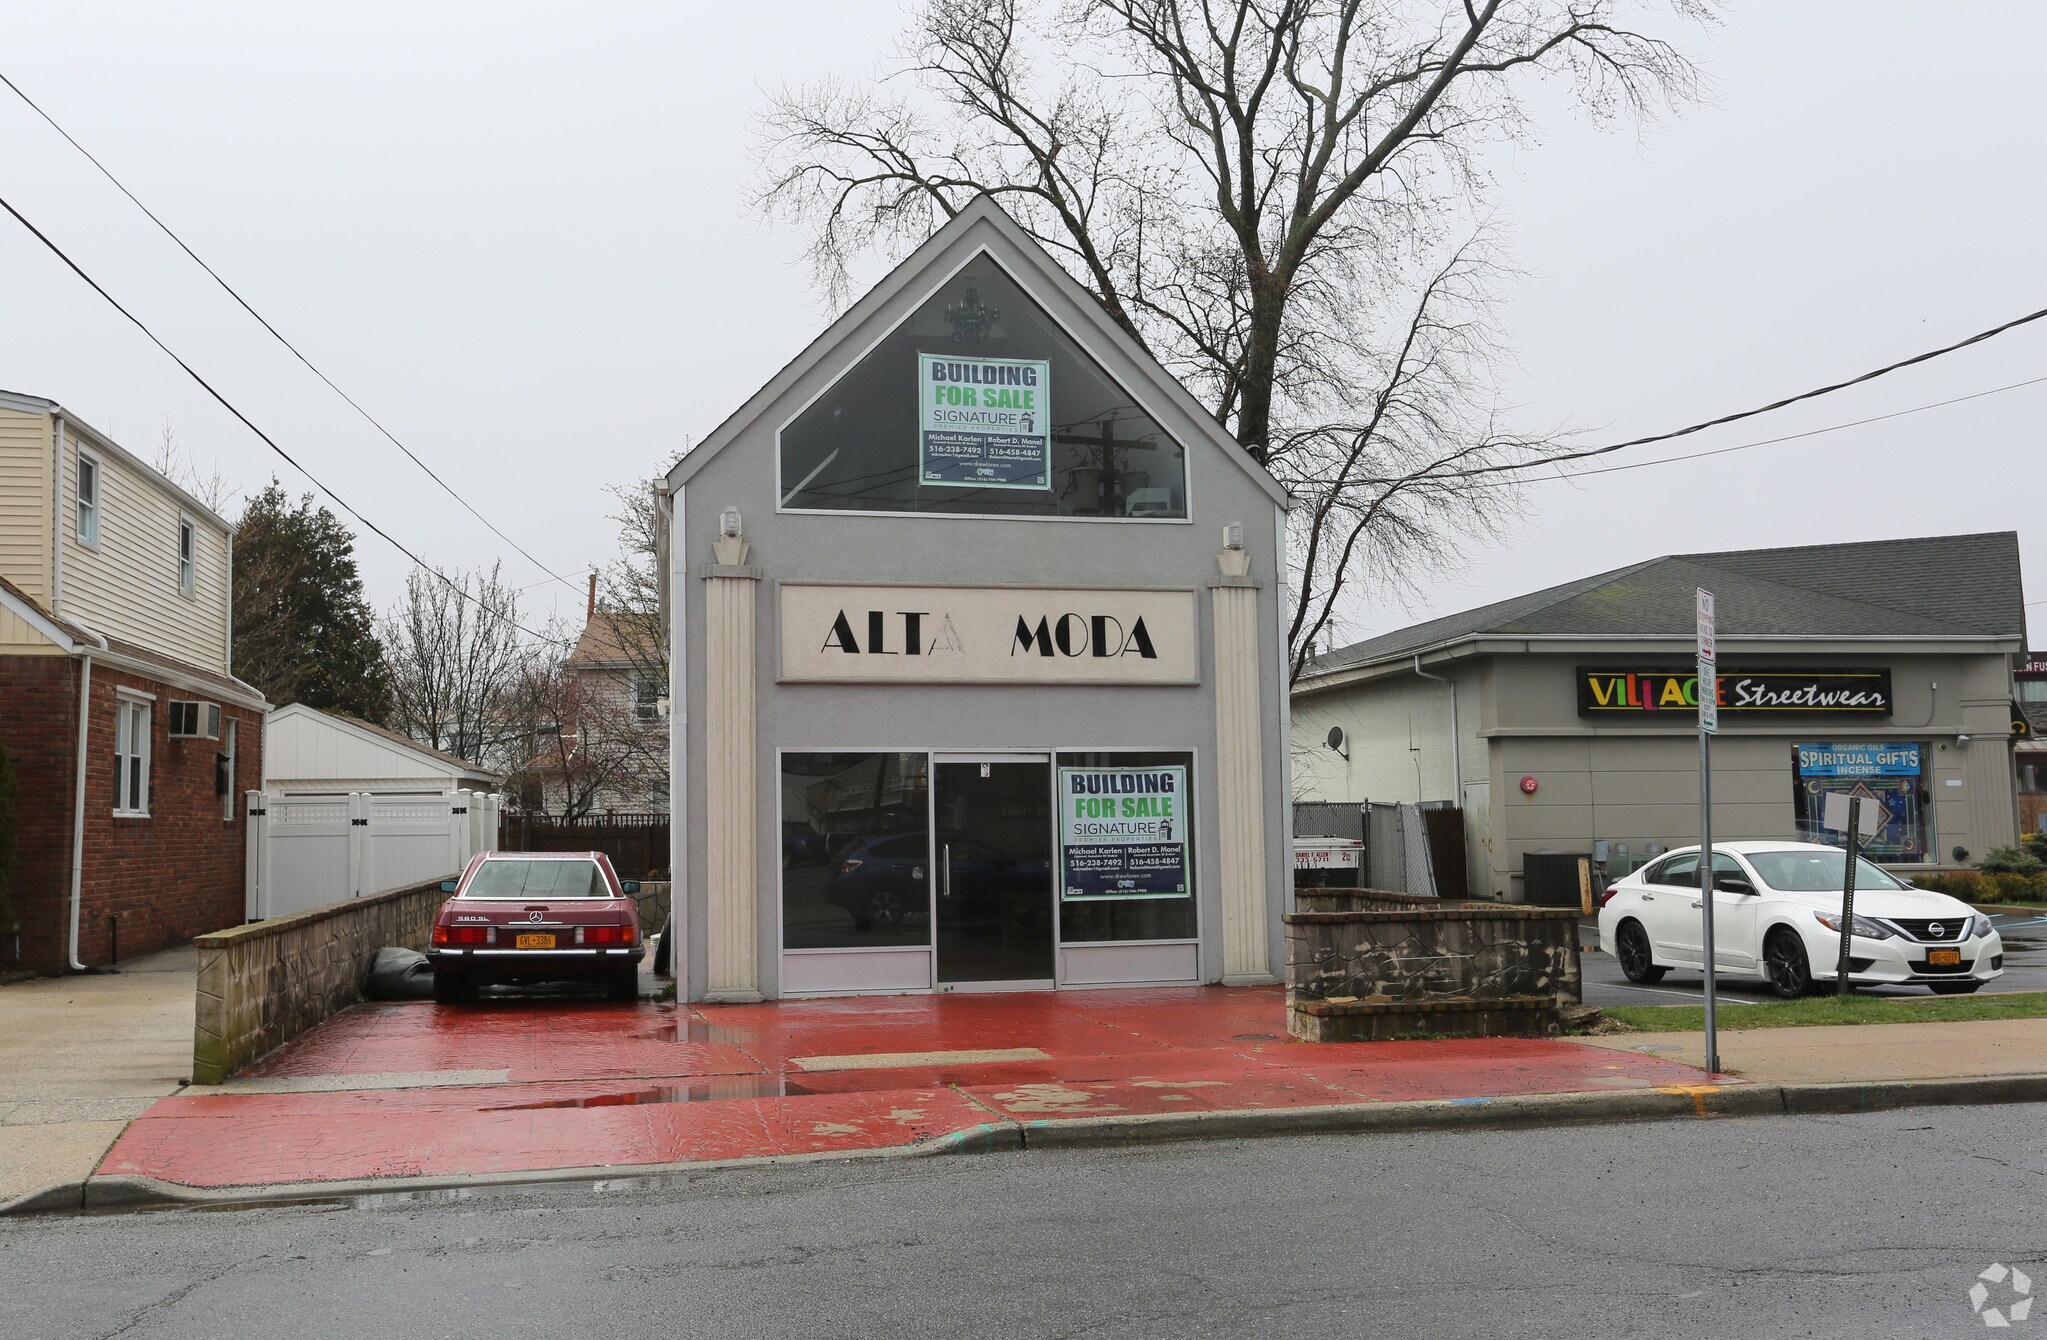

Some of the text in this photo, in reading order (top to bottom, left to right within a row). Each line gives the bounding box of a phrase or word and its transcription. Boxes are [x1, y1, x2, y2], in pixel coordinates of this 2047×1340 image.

[932, 361, 1037, 387] BUILDING
[935, 385, 1034, 410] FOR SALE
[933, 409, 1017, 425] SIGNATURE
[971, 425, 1018, 433] PROPERTIES
[928, 433, 982, 443] Michael Karlen
[987, 436, 1043, 446] Robert D. Manel
[929, 445, 982, 454] 516-238-7492
[989, 448, 1041, 457] 516-458-4847
[1010, 613, 1158, 659] MODA
[1734, 678, 1886, 707] Streetwear
[1800, 750, 1919, 768] SPIRITUAL GIFTS
[1837, 766, 1882, 774] INCENSE
[1071, 773, 1174, 794] BUILDING
[1075, 798, 1116, 819] FOR
[1121, 797, 1173, 818] SALE
[1074, 822, 1157, 835] SIGNATURE
[1069, 847, 1122, 855] Michael Karlen
[1127, 846, 1150, 854] Robert
[1160, 845, 1181, 853] Manel
[1070, 858, 1122, 867] 516-238-7492
[1130, 857, 1180, 865] 516-458-4847
[519, 935, 552, 945] GVL-3386
